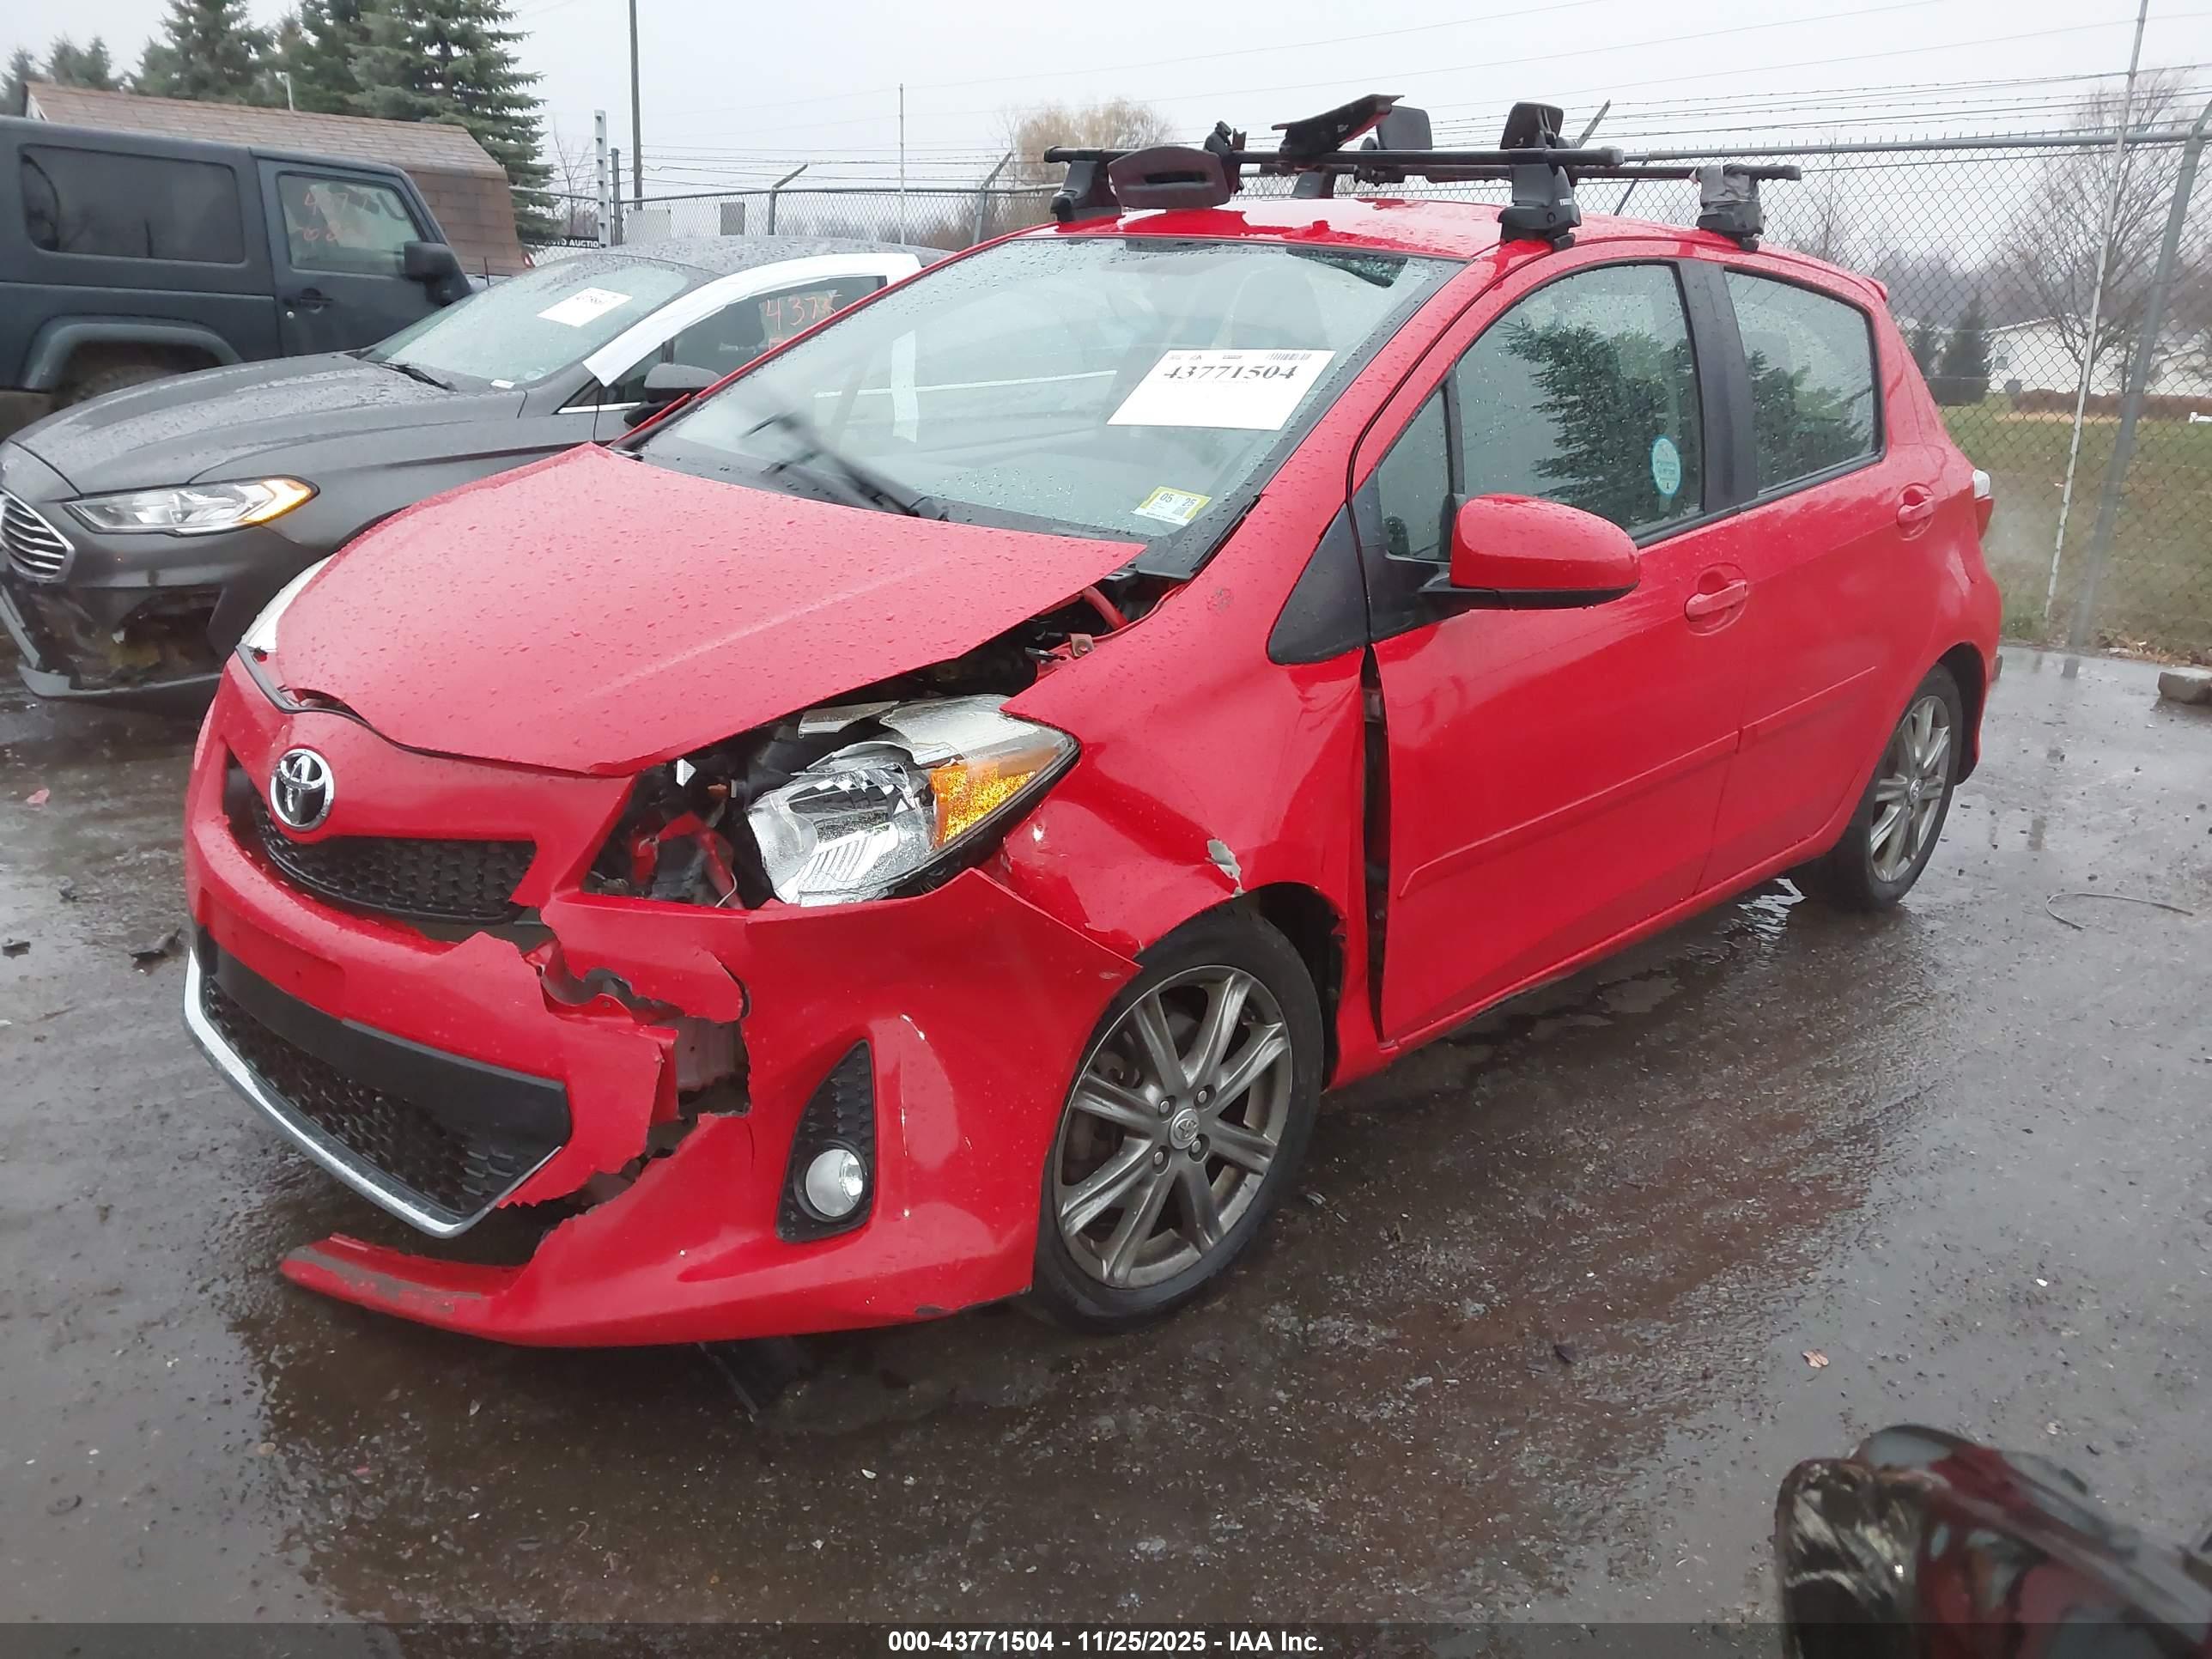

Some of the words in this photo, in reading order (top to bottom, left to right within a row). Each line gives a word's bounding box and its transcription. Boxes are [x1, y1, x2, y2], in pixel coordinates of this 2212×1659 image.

[568, 239, 599, 248] AUCTIO
[1164, 365, 1299, 380] 43771504
[1159, 493, 1176, 503] 05
[1182, 497, 1198, 507] 25
